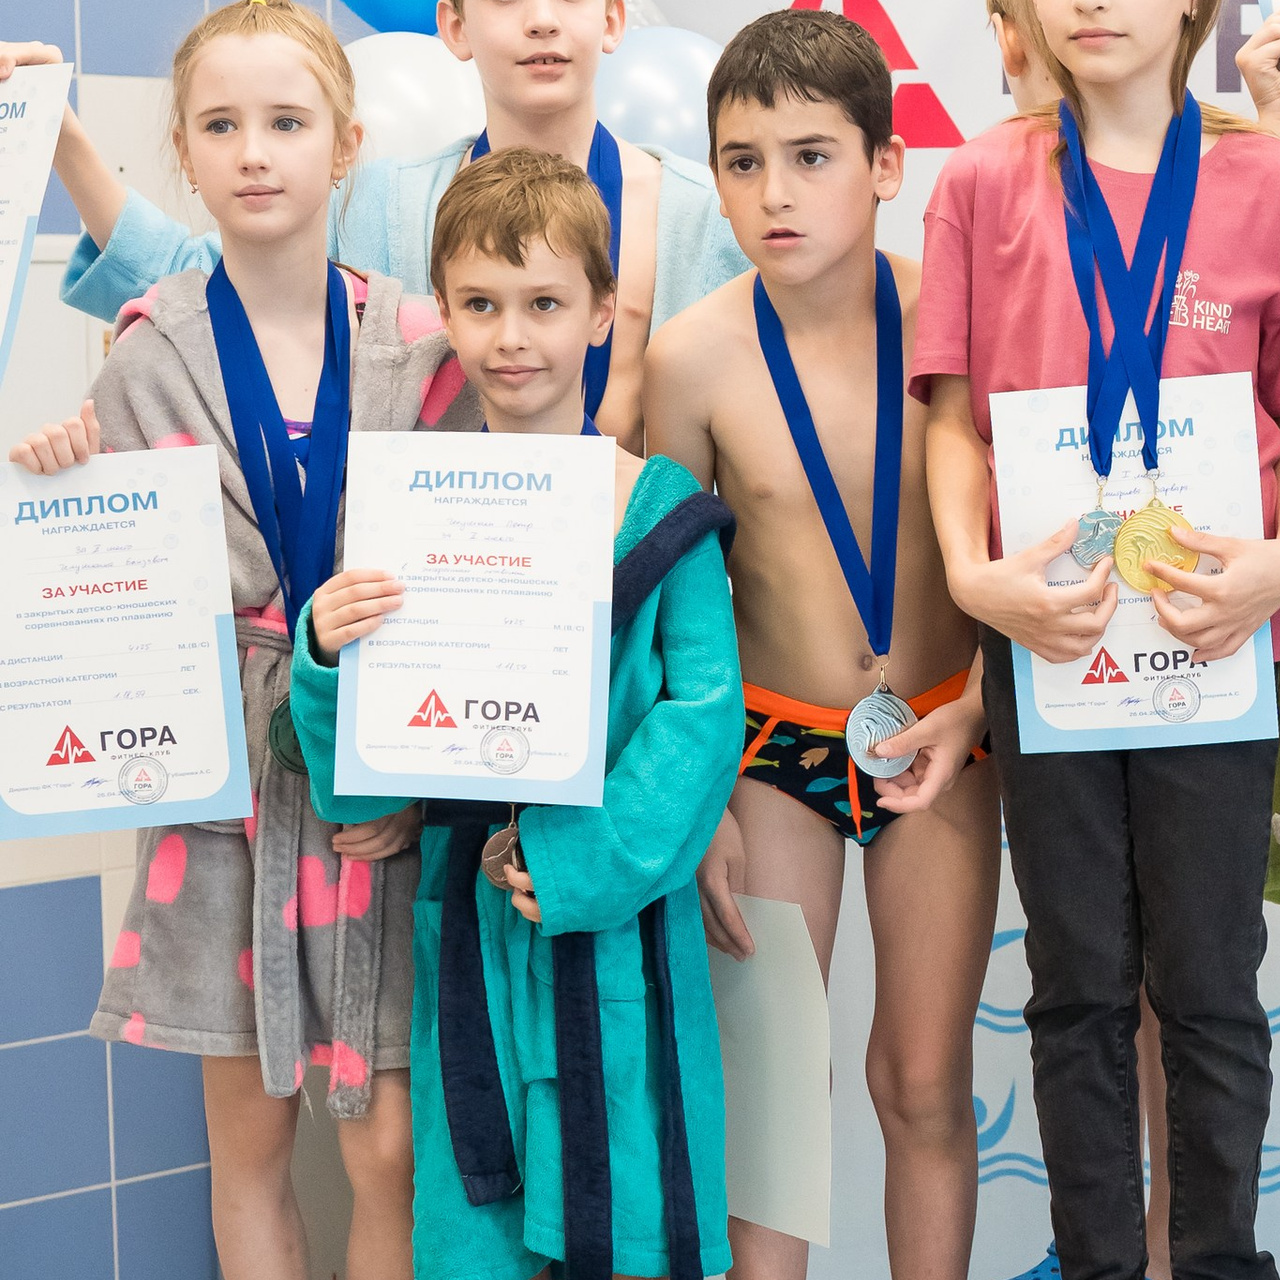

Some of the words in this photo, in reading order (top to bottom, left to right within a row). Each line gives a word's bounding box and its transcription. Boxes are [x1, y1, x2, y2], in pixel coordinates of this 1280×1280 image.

[1194, 300, 1232, 319] KIND
[409, 470, 552, 492] ДИПЛОМ
[15, 491, 158, 525] ДИПЛОМ
[434, 496, 527, 506] НАГРАЖДАЕТСЯ
[42, 520, 136, 535] НАГРАЖДАЕТСЯ
[426, 554, 449, 564] ЗА
[453, 554, 532, 567] УЧАСТИЕ
[405, 575, 456, 583] закрытых
[457, 576, 558, 585] детско-юношеских
[42, 588, 65, 599] ЗА
[69, 579, 148, 597] УЧАСТИЕ
[404, 586, 484, 594] соревнованиях
[24, 608, 75, 620] закрытых
[77, 599, 177, 613] детско-юношеских
[25, 618, 105, 630] соревнованиях
[107, 616, 119, 624] по
[121, 611, 173, 622] плаванию
[383, 617, 439, 625] ДИСТАНЦИИ
[439, 641, 490, 649] КАТЕГОРИИ
[7, 654, 63, 666] ДИСТАНЦИИ
[1133, 648, 1207, 673] ГОРА
[4, 676, 65, 688] ВОЗРАСТНОЙ
[66, 672, 118, 683] КАТЕГОРИИ
[7, 699, 72, 711] РЕЗУЛЬТАТОМ
[464, 699, 540, 723] ГОРА
[100, 725, 177, 751] ГОРА
